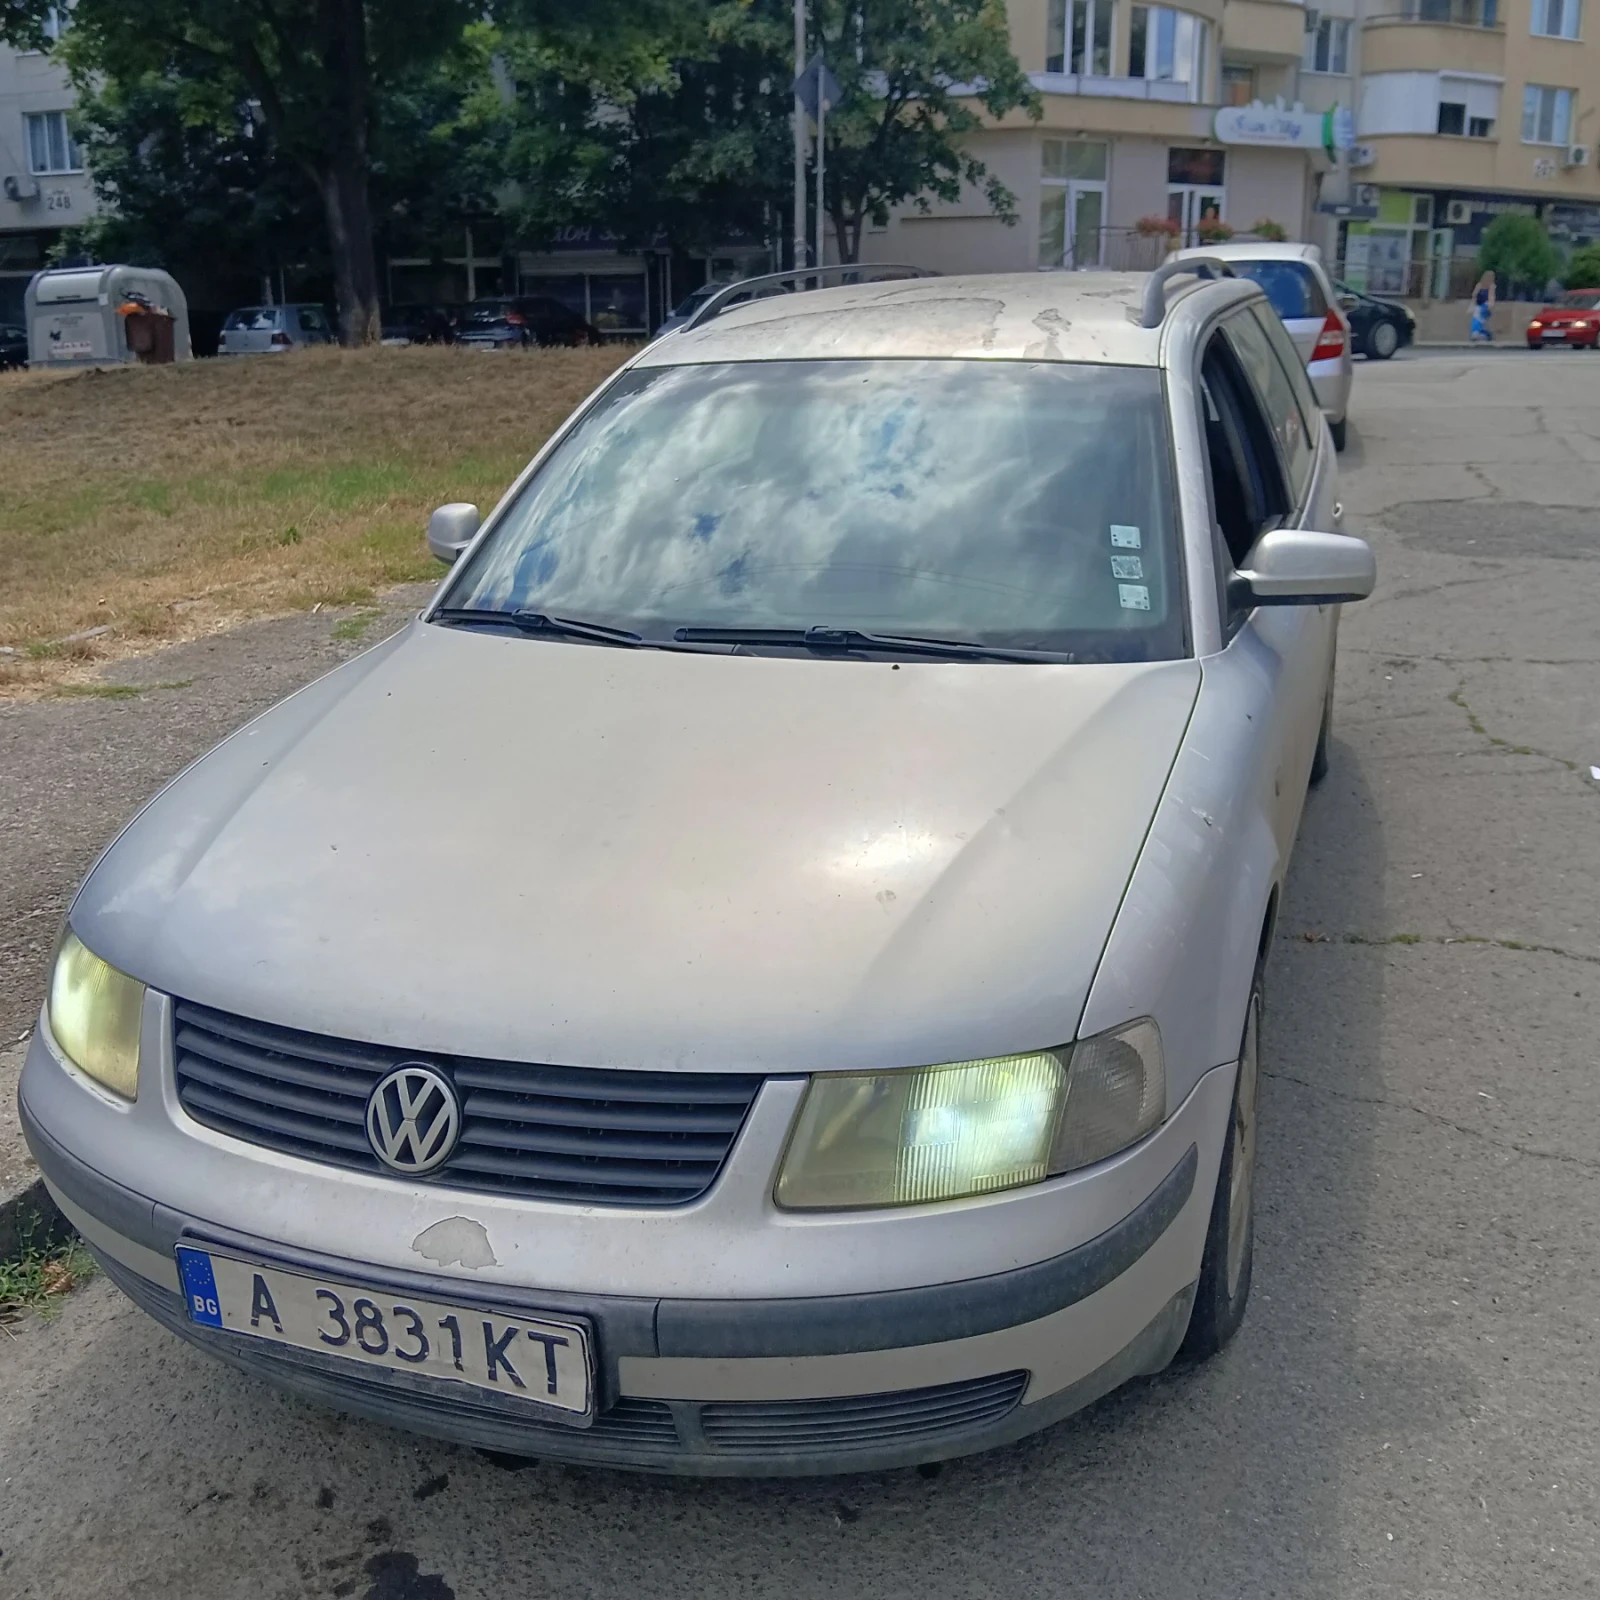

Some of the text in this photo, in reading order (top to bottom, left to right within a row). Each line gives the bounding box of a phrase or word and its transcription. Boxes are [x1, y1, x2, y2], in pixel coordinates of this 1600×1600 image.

[367, 1067, 459, 1172] VW
[193, 1295, 218, 1316] BG
[250, 1272, 285, 1334] A
